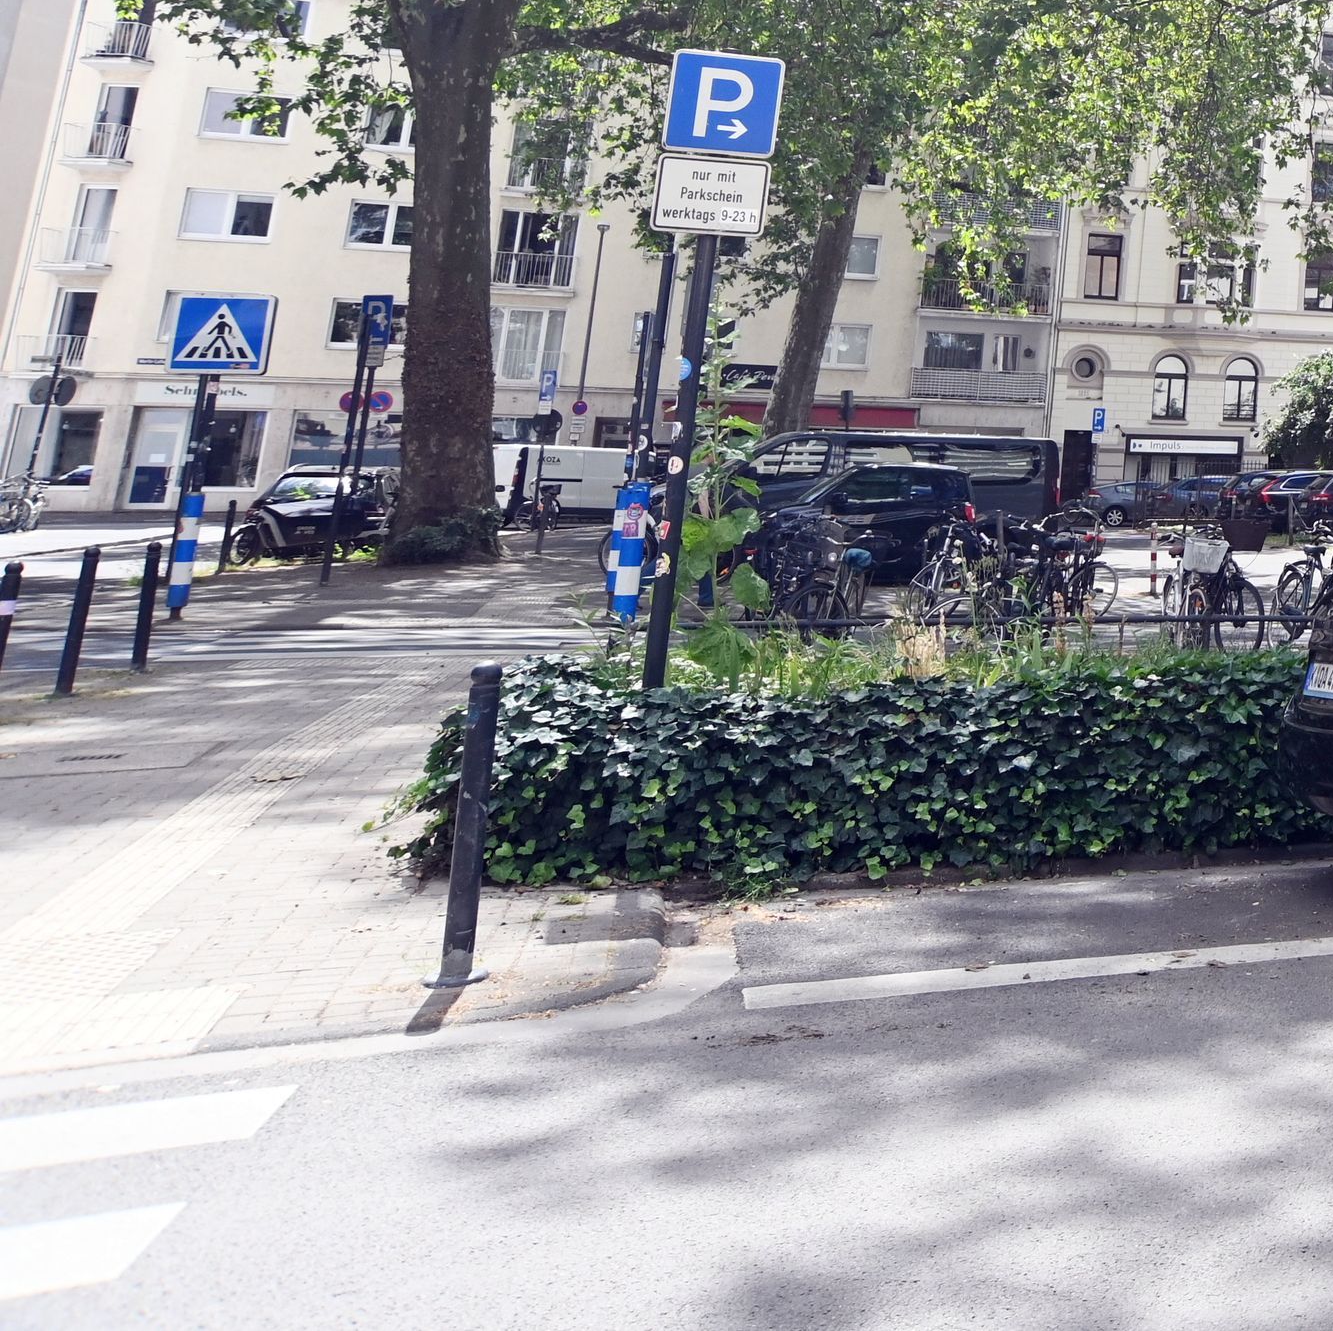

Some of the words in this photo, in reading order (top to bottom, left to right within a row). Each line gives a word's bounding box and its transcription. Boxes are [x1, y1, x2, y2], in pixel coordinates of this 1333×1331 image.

[692, 66, 754, 138] P
[691, 170, 711, 182] nur
[717, 171, 736, 183] mit
[680, 186, 743, 203] Parkschein
[662, 206, 716, 224] werktags
[720, 210, 746, 223] 9-23
[749, 211, 757, 224] h
[542, 373, 554, 393] P
[1094, 410, 1103, 425] P
